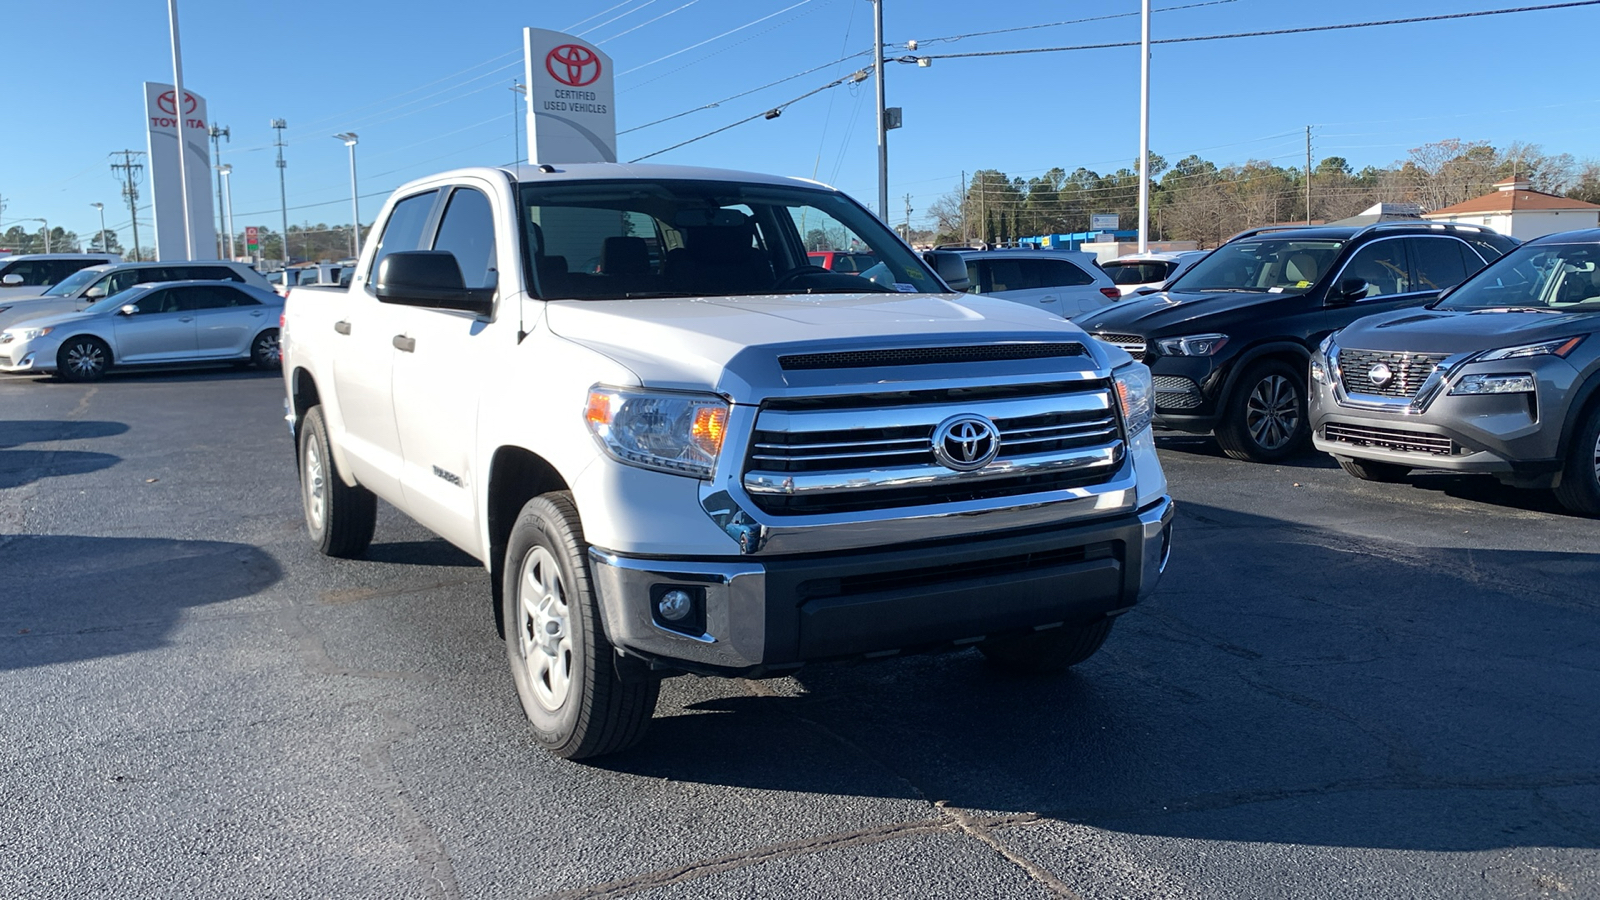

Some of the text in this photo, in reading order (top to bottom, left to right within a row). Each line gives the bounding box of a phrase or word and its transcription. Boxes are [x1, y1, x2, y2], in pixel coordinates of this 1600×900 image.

[555, 89, 596, 101] CERTIFIED
[544, 101, 607, 114] USED VEHICLES
[151, 117, 205, 129] TOYTA
